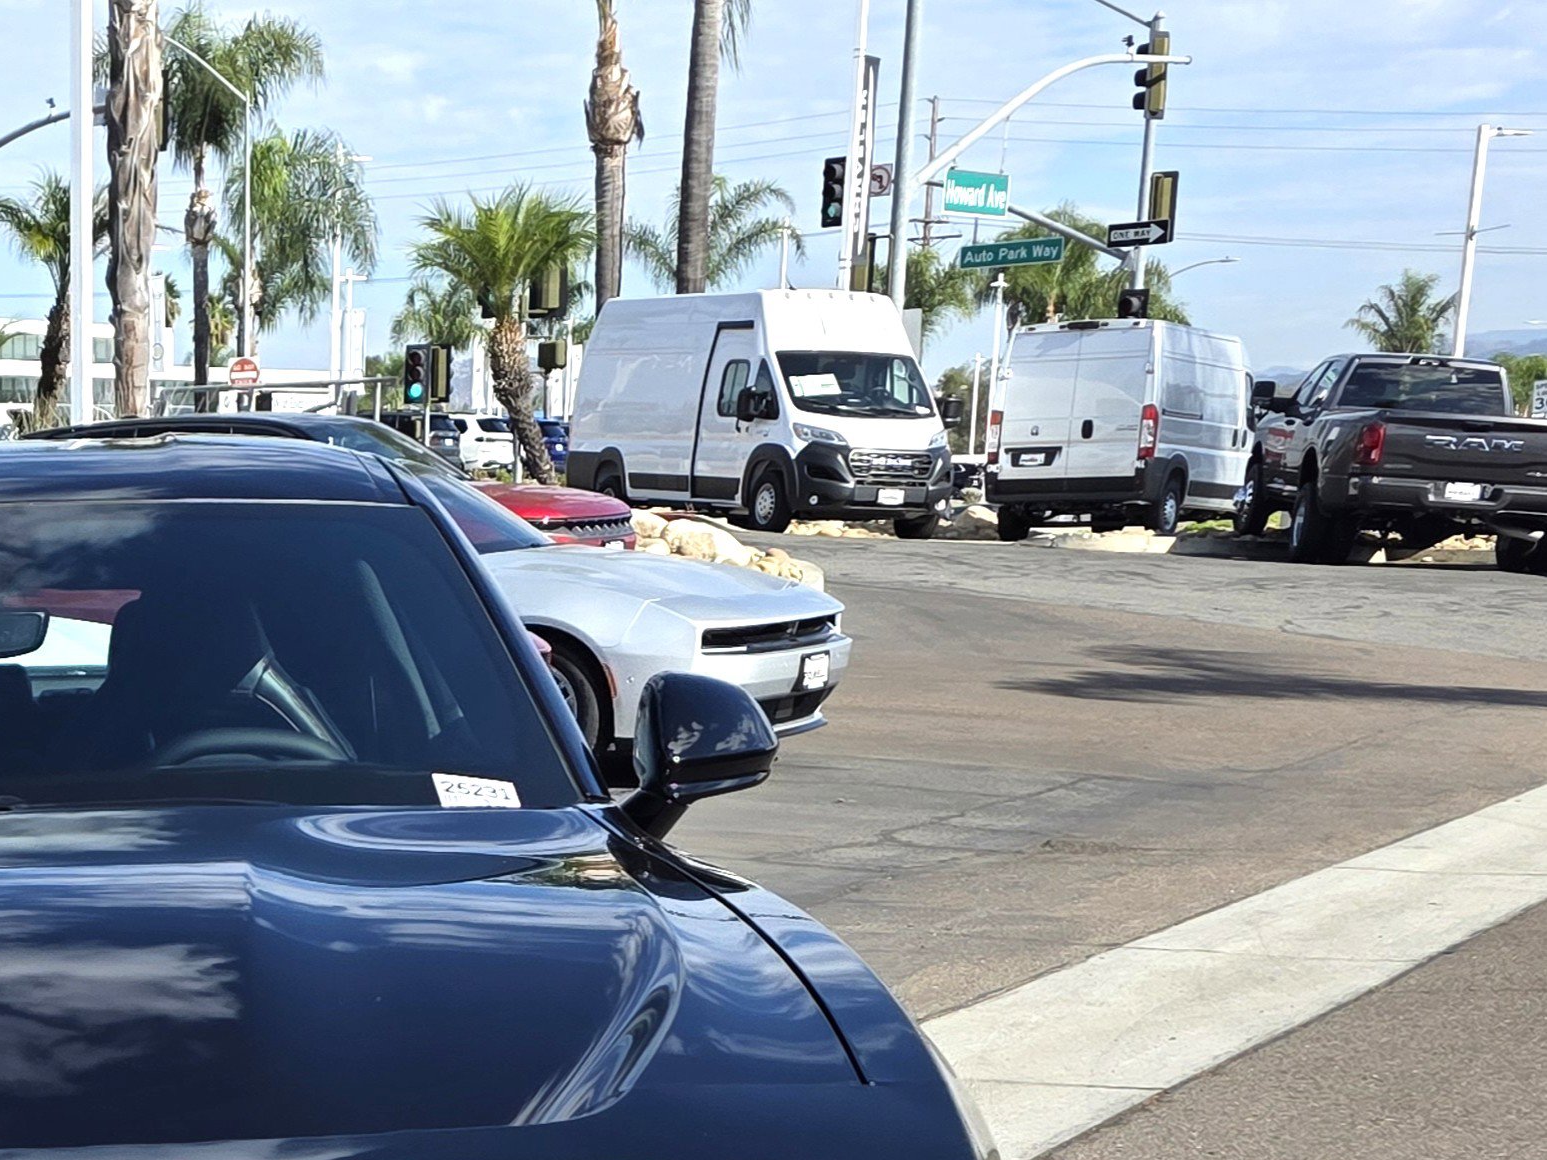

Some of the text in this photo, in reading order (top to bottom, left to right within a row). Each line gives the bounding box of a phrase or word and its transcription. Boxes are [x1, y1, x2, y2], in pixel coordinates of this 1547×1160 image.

[946, 179, 1007, 210] Howard Ave
[1112, 229, 1152, 240] ONE WAY
[964, 244, 1059, 263] Auto Park Way
[1534, 397, 1547, 410] 3
[1425, 435, 1525, 452] RAM
[440, 781, 511, 800] 25231
